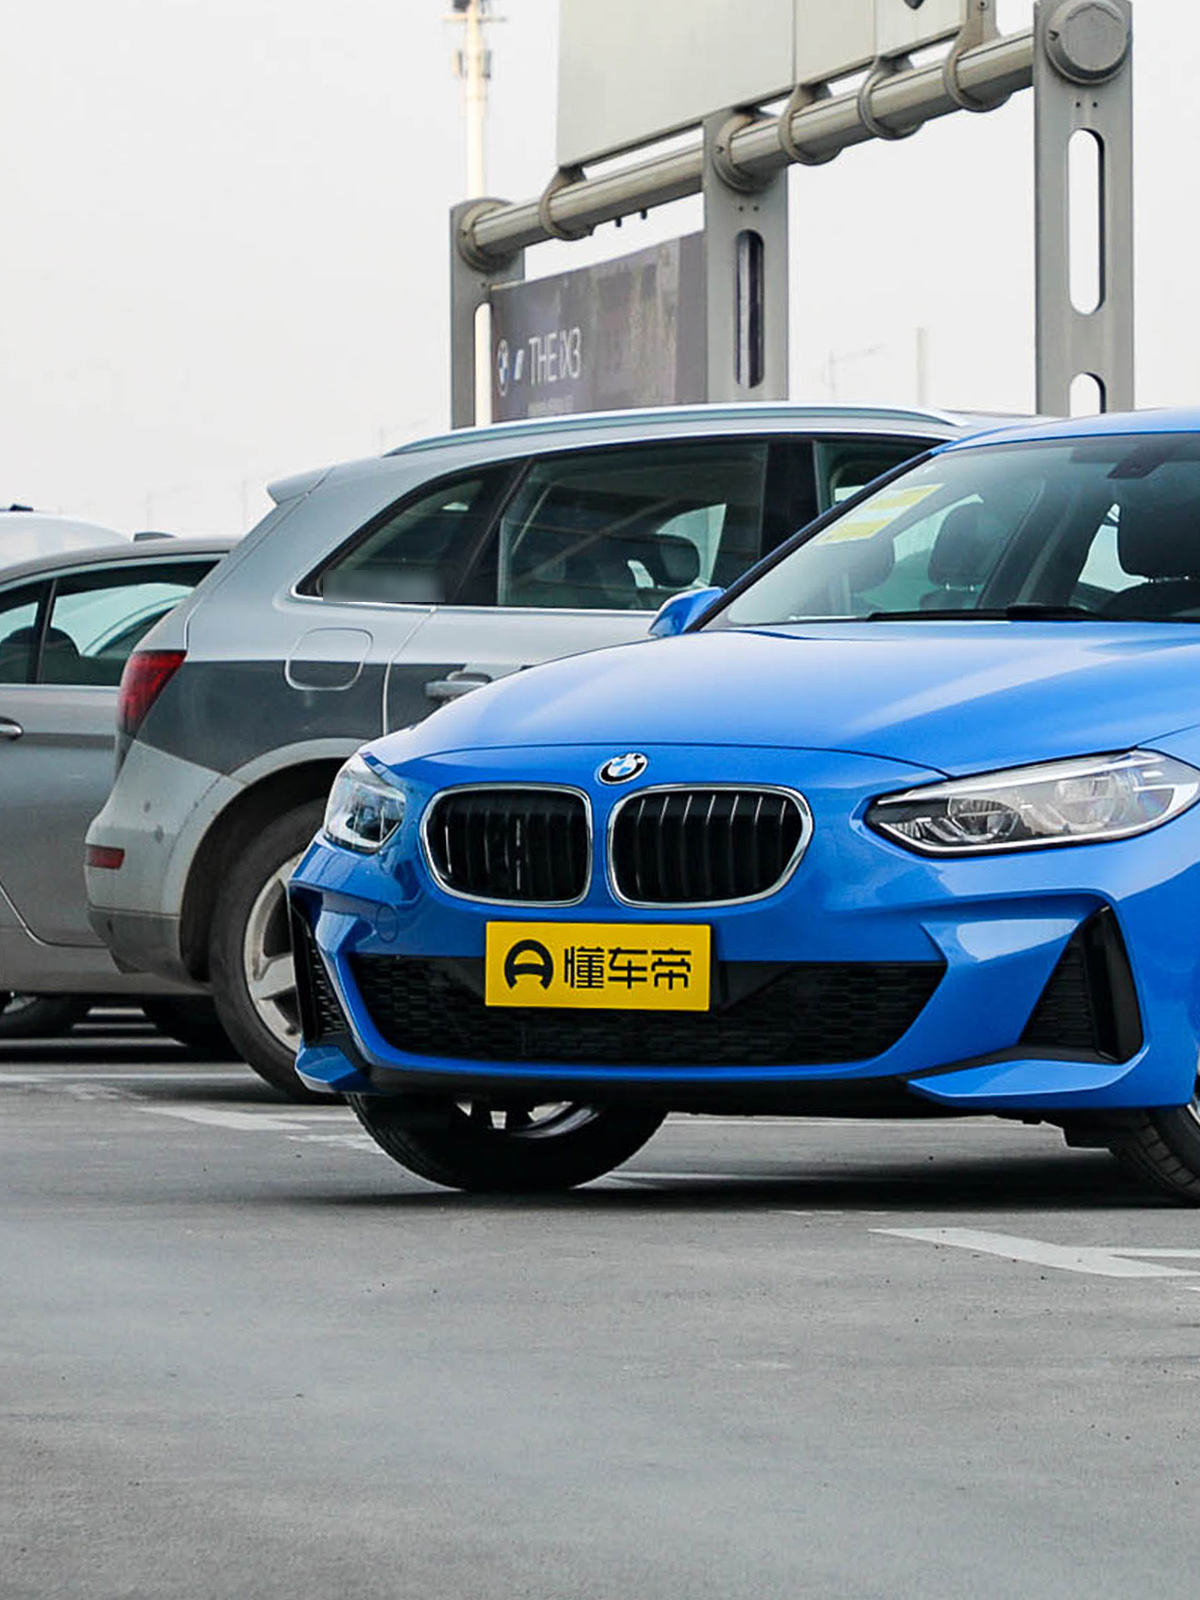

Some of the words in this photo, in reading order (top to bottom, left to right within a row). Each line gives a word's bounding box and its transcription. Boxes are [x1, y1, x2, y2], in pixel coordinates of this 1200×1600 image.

[528, 332, 558, 386] THE
[563, 946, 692, 990] 懂车帝
